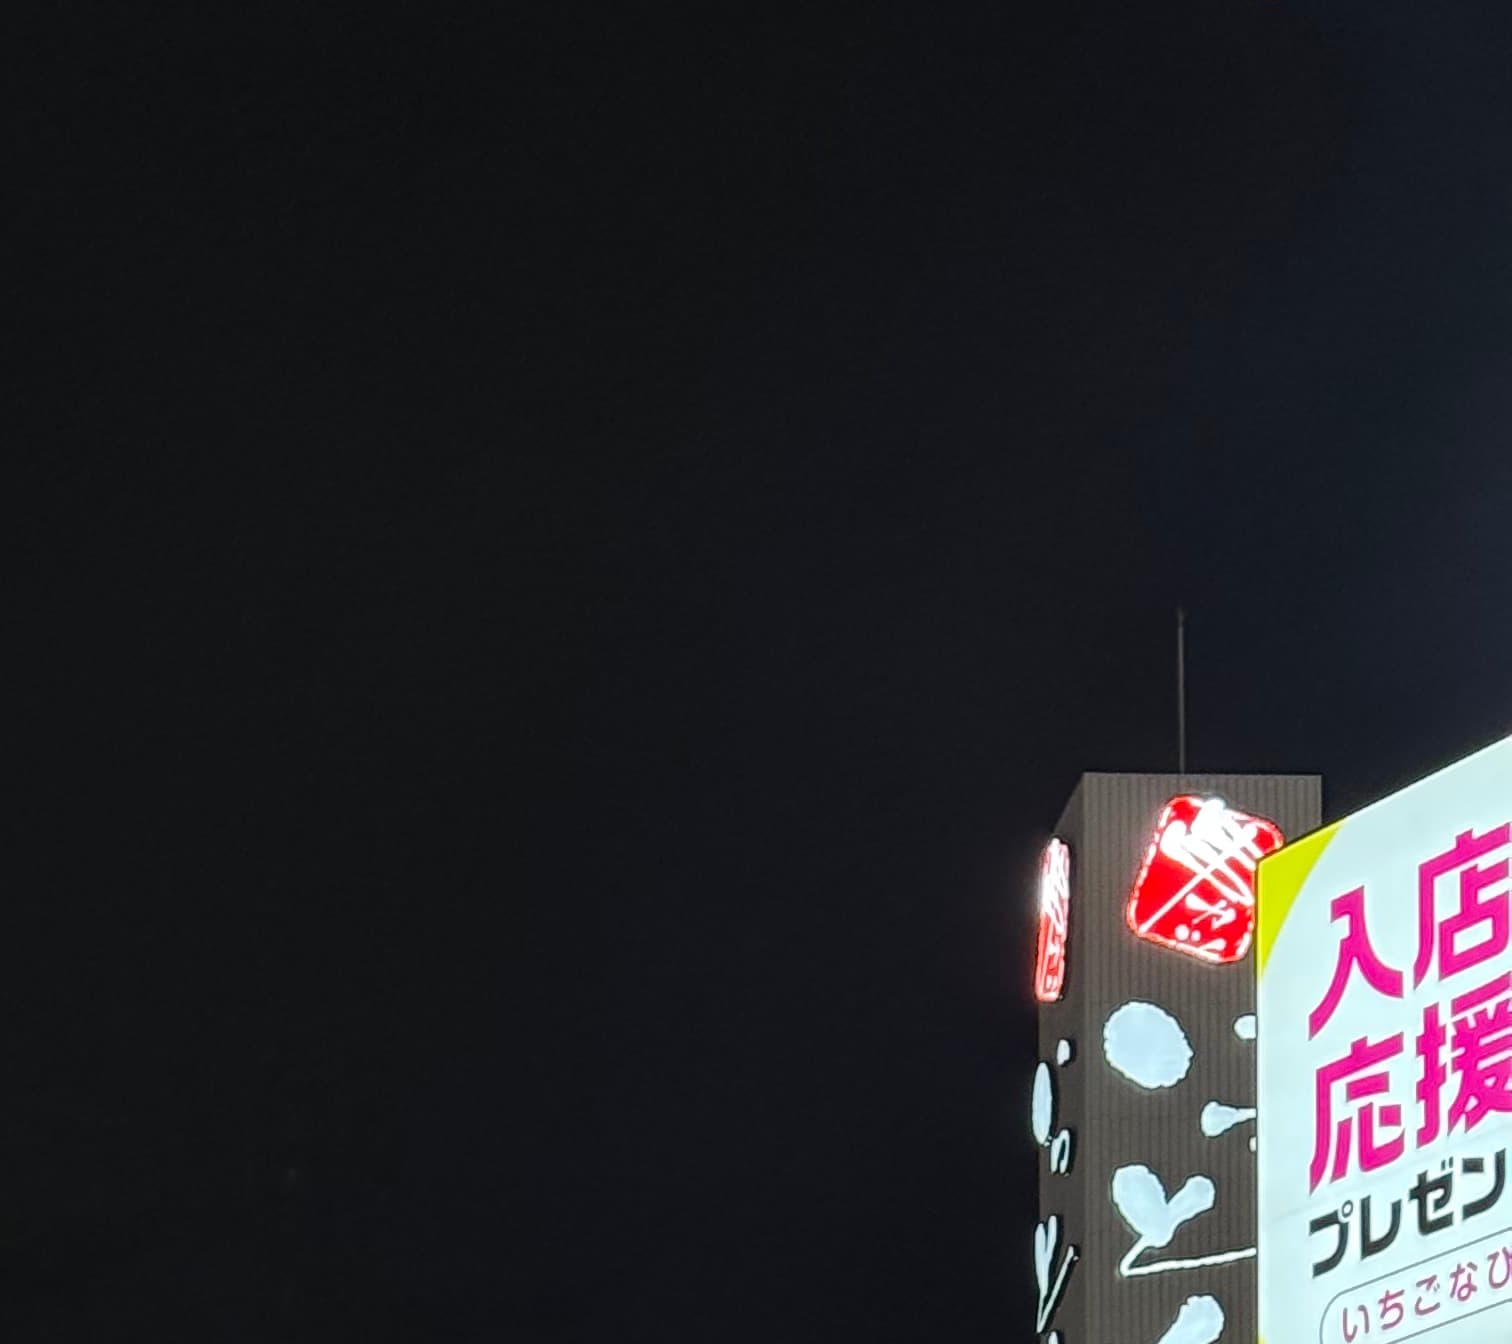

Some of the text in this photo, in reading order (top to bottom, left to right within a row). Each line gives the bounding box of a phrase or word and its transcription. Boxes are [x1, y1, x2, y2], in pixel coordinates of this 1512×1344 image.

[1308, 822, 1511, 1042] 入店
[1308, 970, 1512, 1197] 応援
[1308, 1147, 1508, 1281] プレゼン
